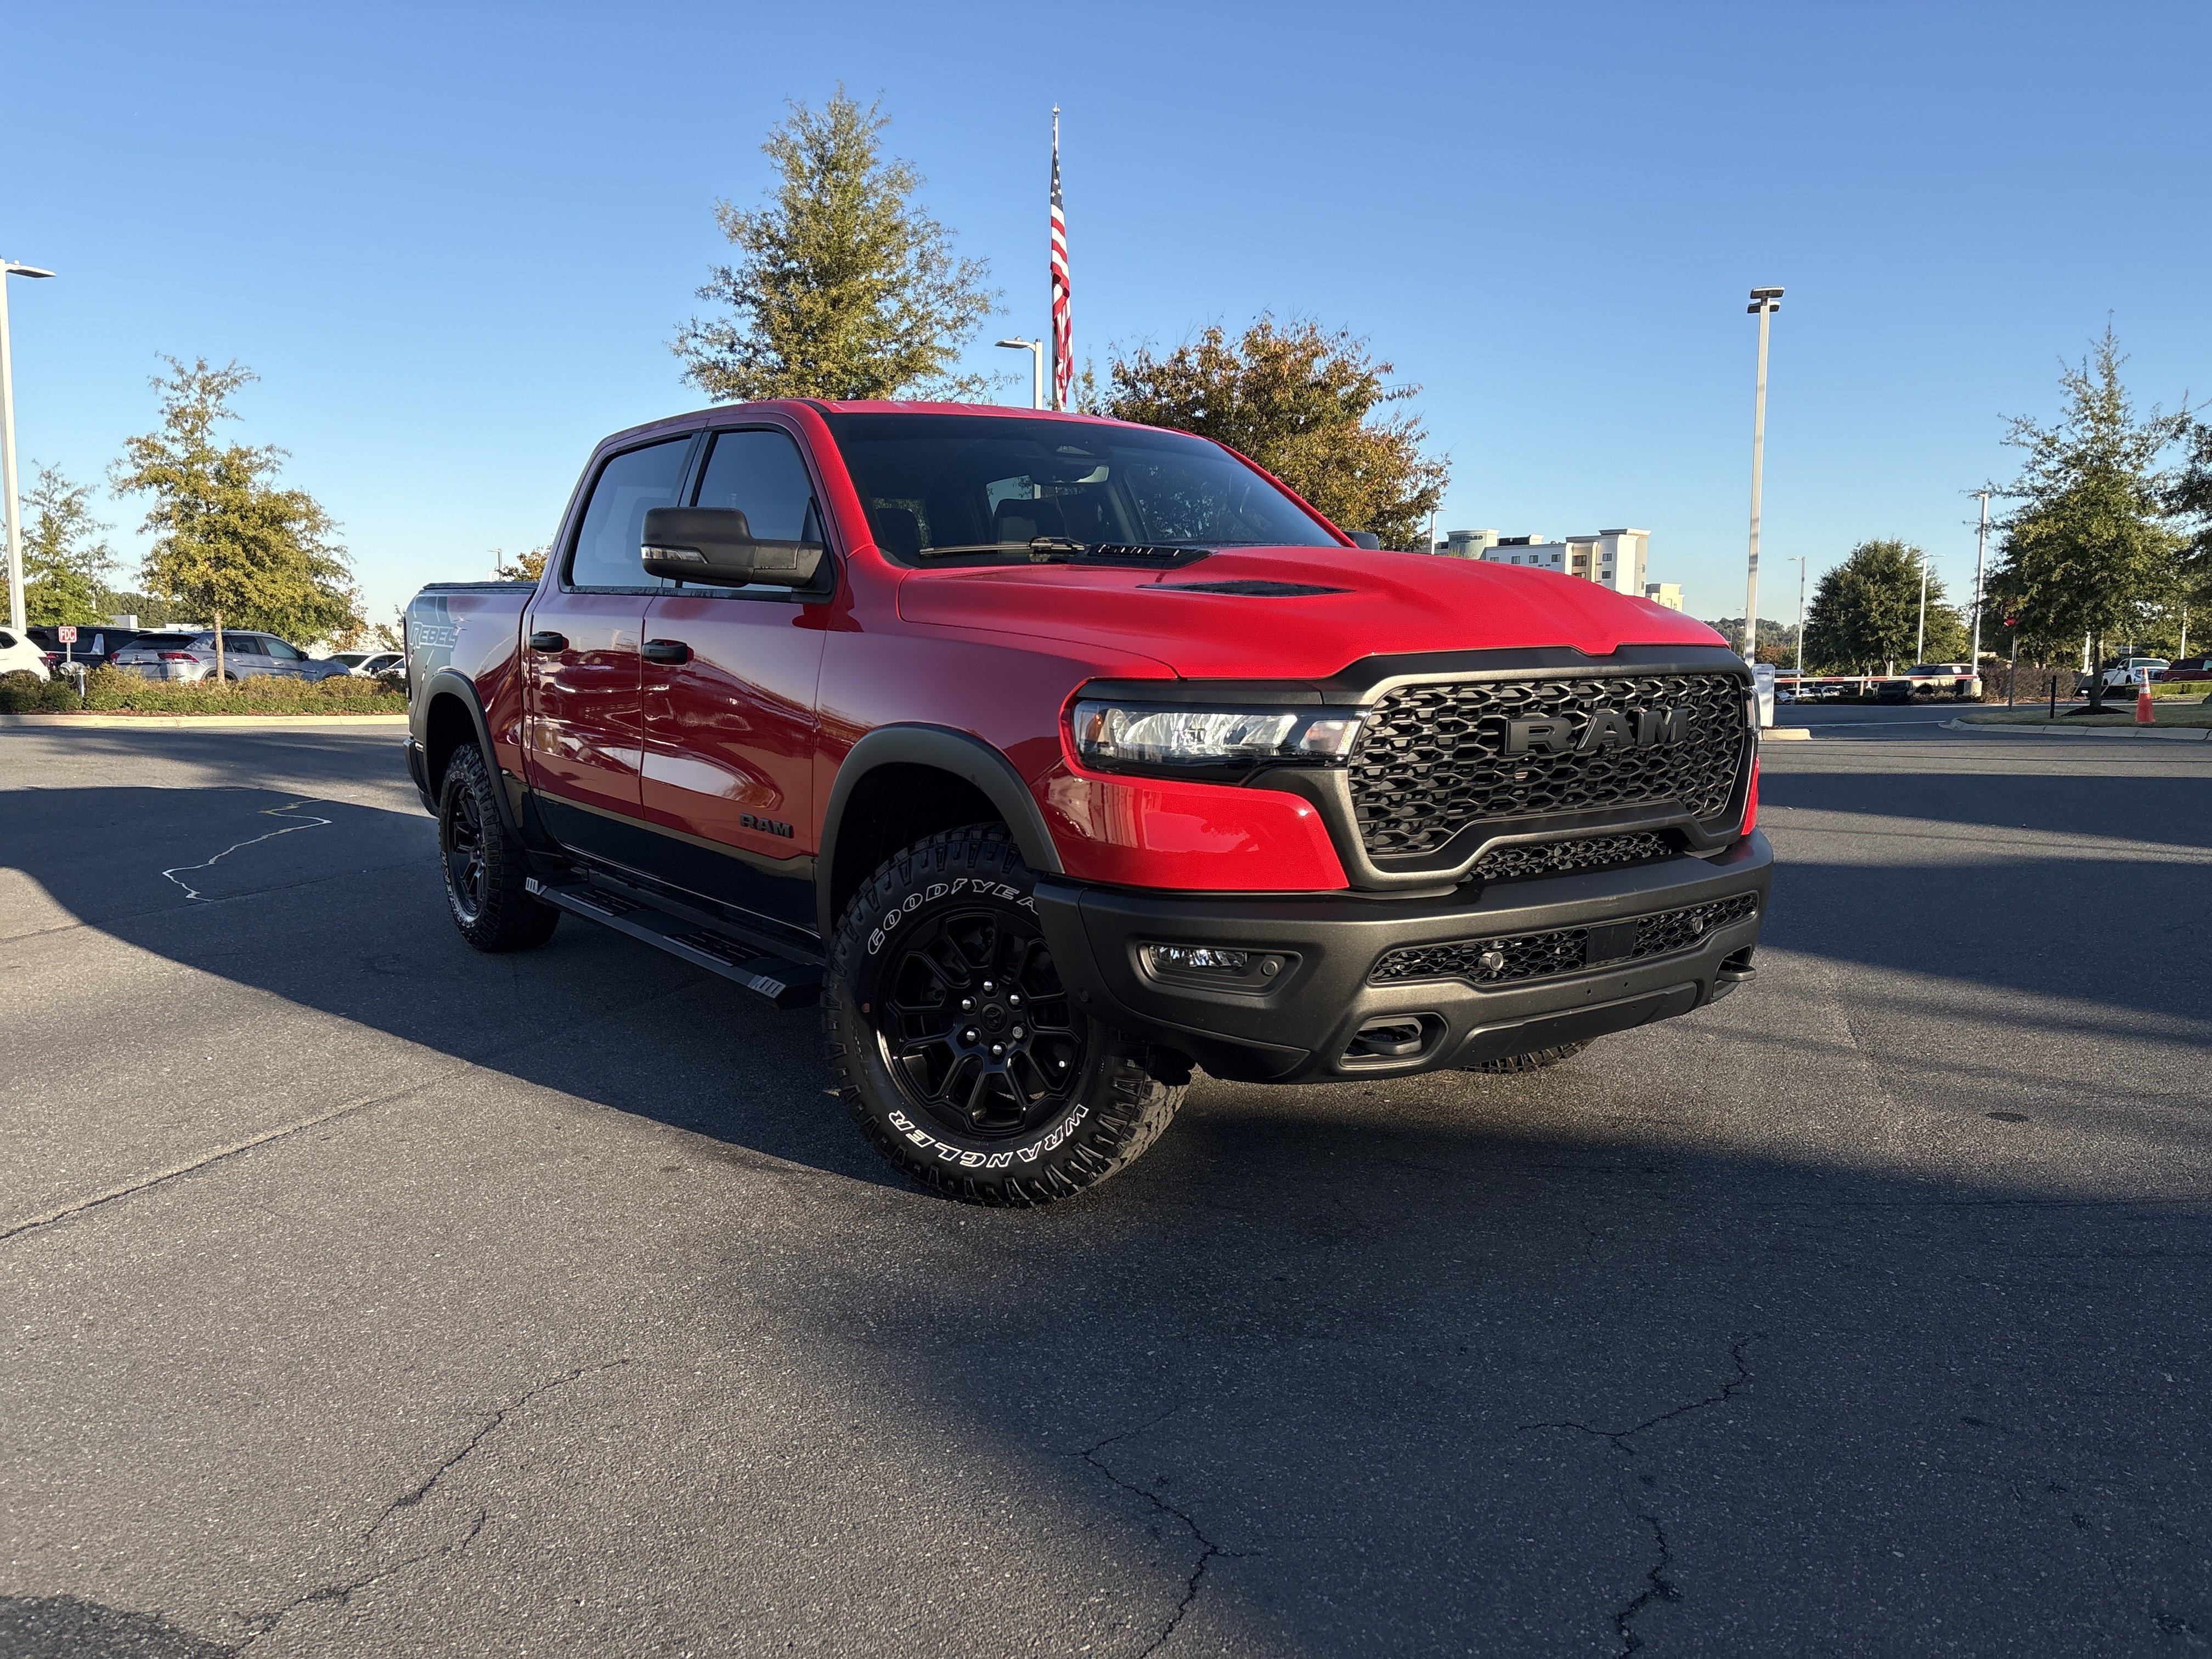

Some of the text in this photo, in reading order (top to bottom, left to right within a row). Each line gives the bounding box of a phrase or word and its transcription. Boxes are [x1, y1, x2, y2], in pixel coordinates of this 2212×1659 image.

[60, 628, 75, 640] FDC
[409, 621, 459, 649] REBEL
[1505, 708, 1690, 755] RAM
[740, 812, 795, 839] RAM
[867, 878, 1040, 955] GOODYEA
[888, 1103, 1089, 1168] WRANGLER
